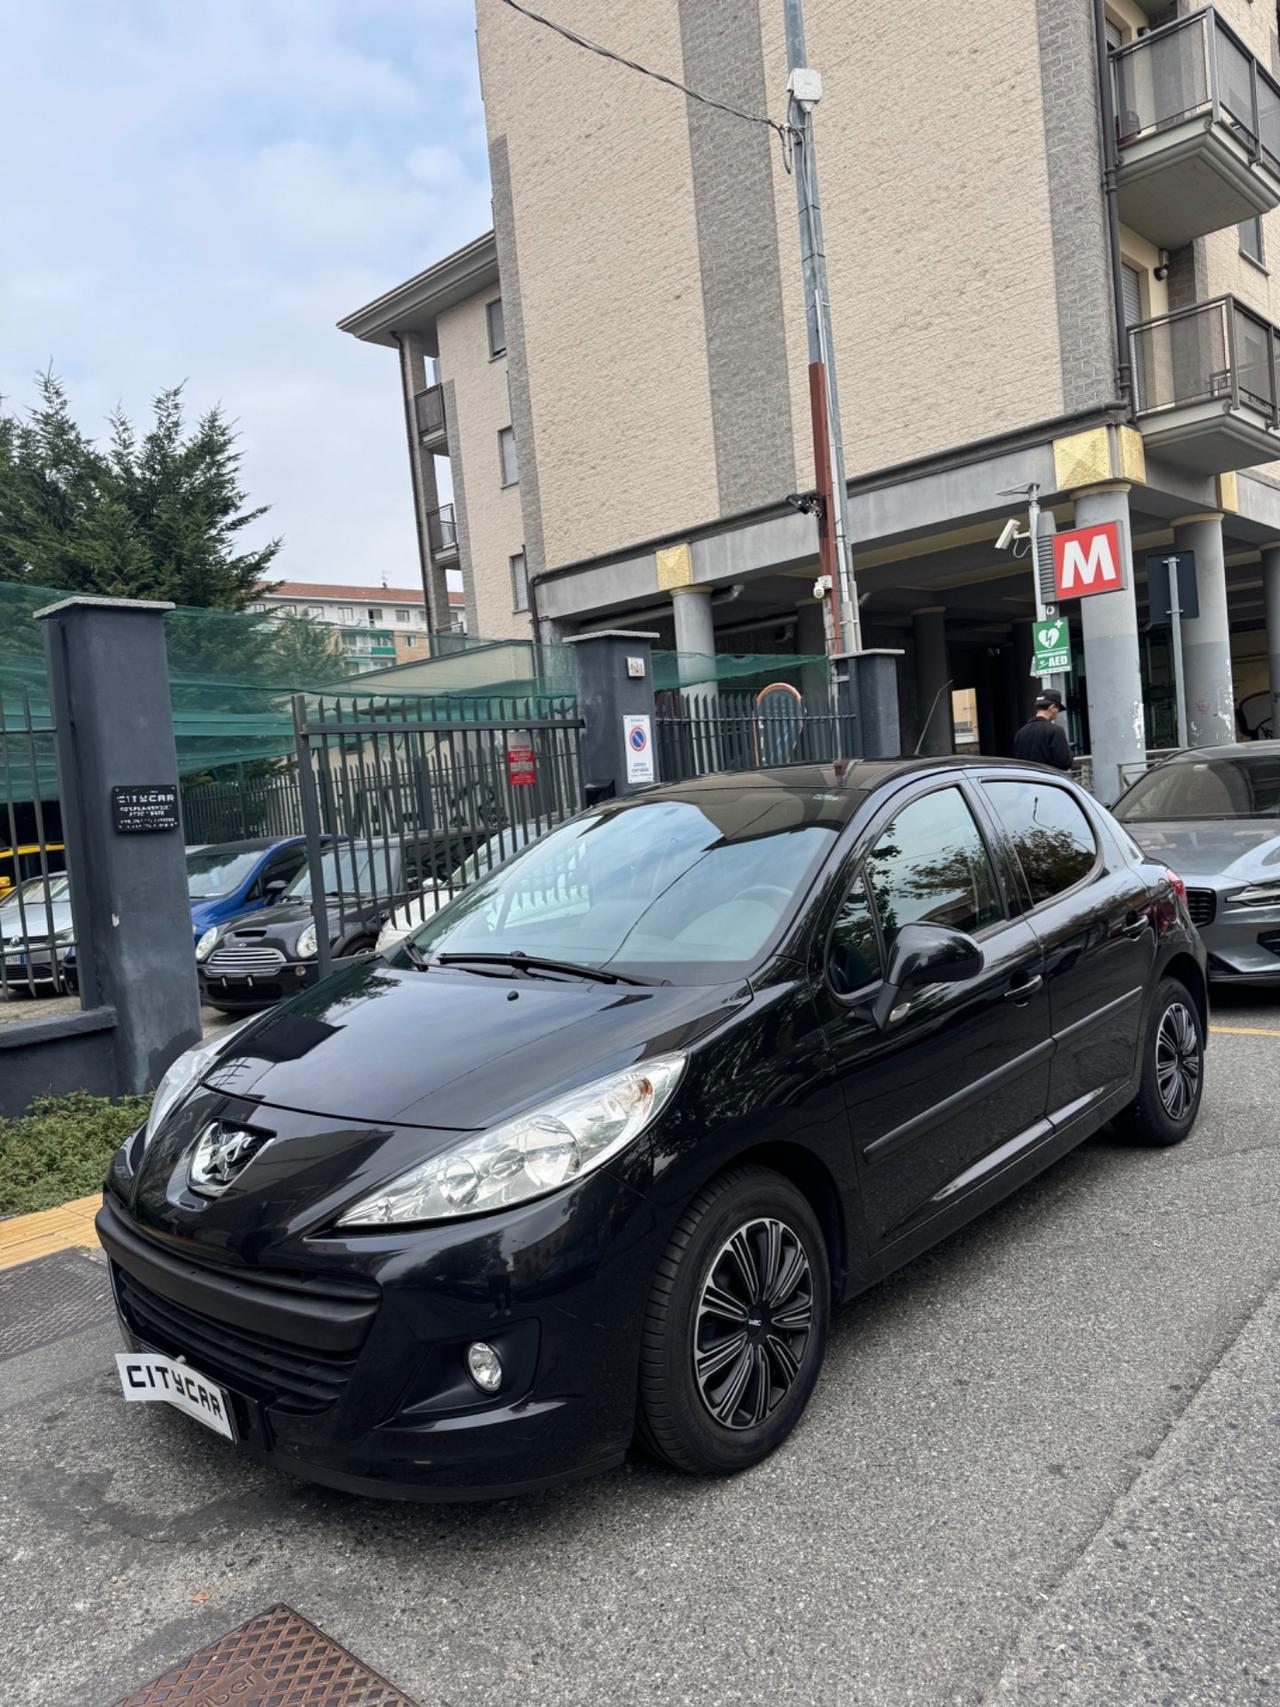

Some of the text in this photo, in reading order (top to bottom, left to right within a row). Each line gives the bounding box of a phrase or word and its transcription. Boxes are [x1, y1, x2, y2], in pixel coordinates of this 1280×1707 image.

[1061, 534, 1117, 589] M
[1048, 655, 1068, 667] AED
[117, 794, 175, 803] CITYCAR
[126, 1365, 223, 1421] CITYCAR
